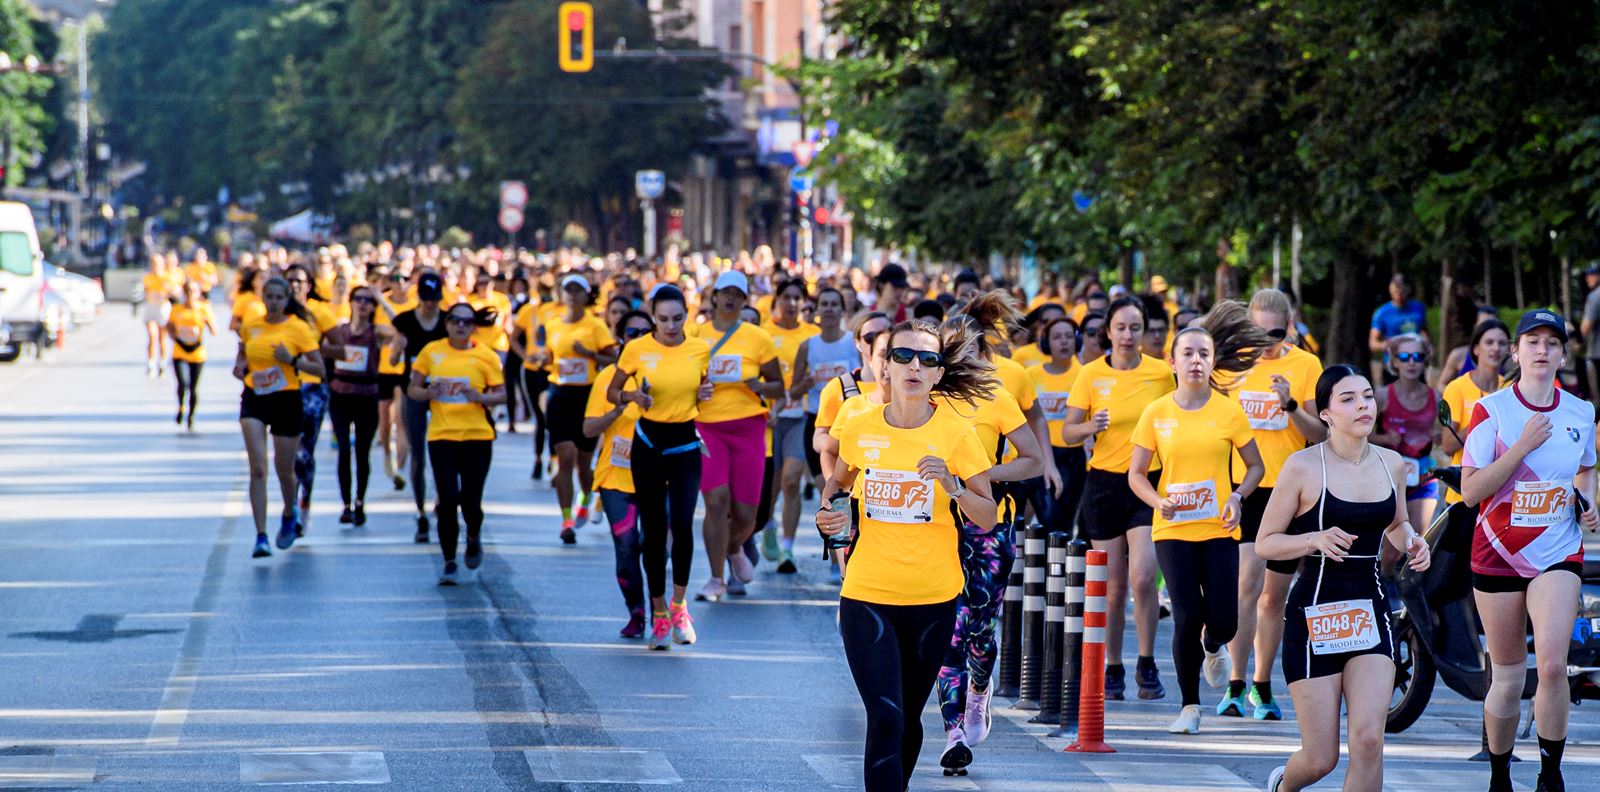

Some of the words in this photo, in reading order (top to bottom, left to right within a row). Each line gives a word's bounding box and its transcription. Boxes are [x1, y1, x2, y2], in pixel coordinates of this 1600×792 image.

[867, 482, 901, 499] 5286
[1515, 493, 1547, 508] 3107
[1527, 515, 1562, 523] BIODERMA
[1312, 614, 1350, 635] 5048
[1329, 639, 1370, 649] BIODERMA
